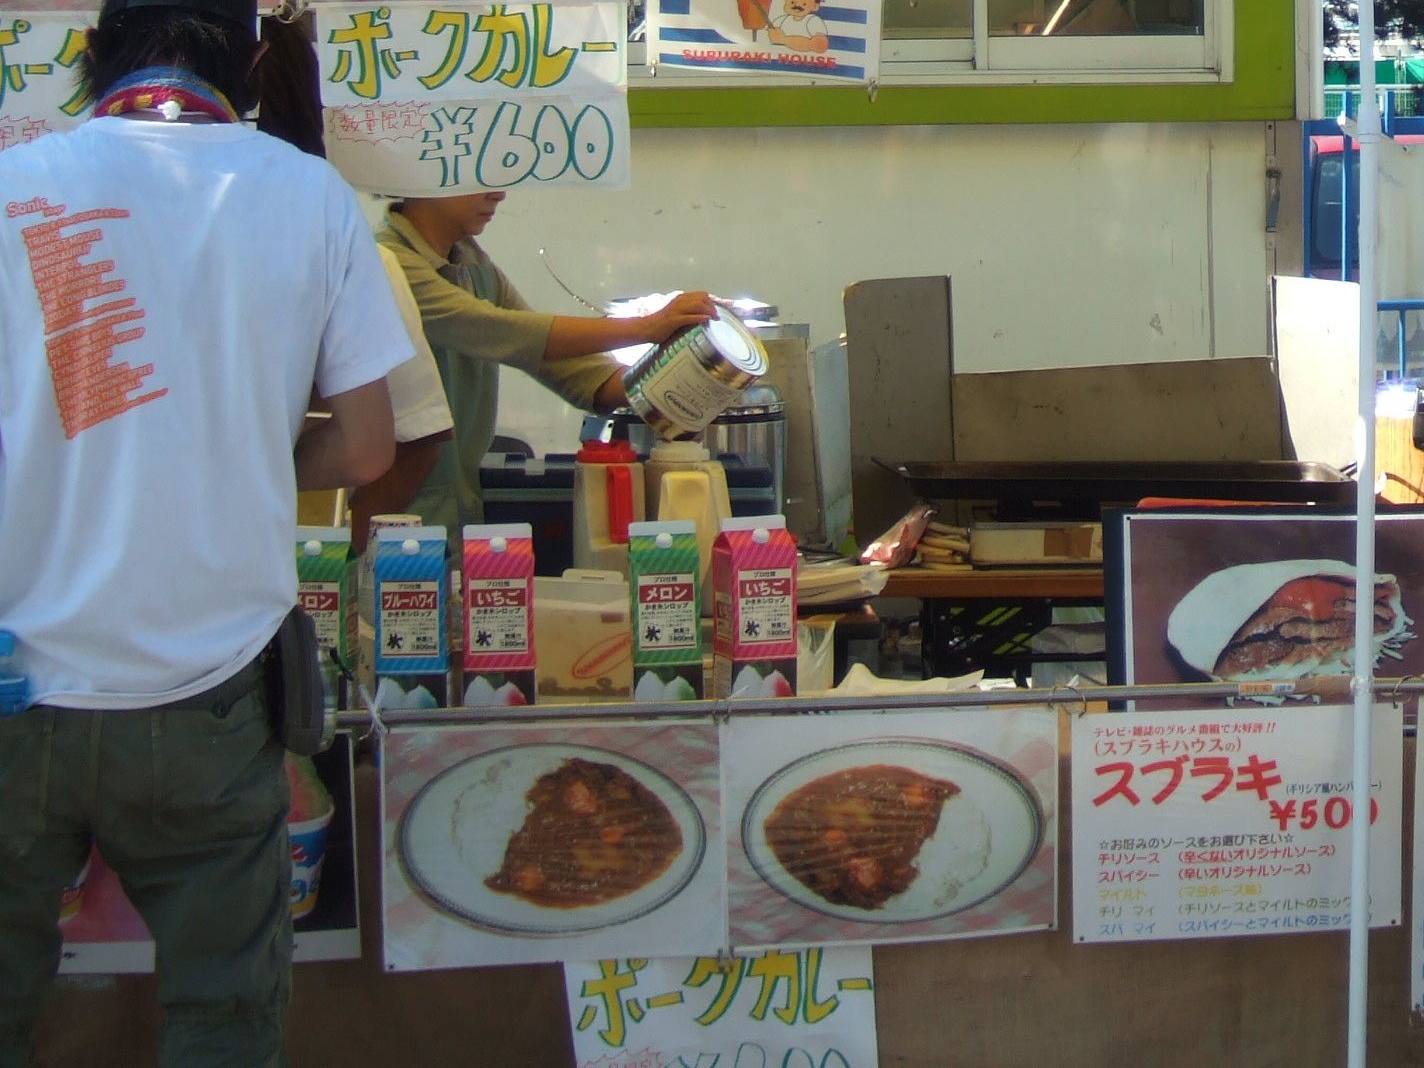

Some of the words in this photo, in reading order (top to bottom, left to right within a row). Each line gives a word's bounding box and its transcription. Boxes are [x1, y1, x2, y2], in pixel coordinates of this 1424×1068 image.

[329, 4, 618, 100] ポークカレー
[420, 102, 615, 188] ¥600
[646, 587, 687, 601] メロン
[745, 580, 785, 596] いちご
[383, 594, 436, 609] ブルーハワイ
[477, 590, 520, 605] いちご
[1092, 754, 1283, 807] スブラキ
[1098, 853, 1161, 865] チリソース
[576, 948, 873, 1047] ポークカレー
